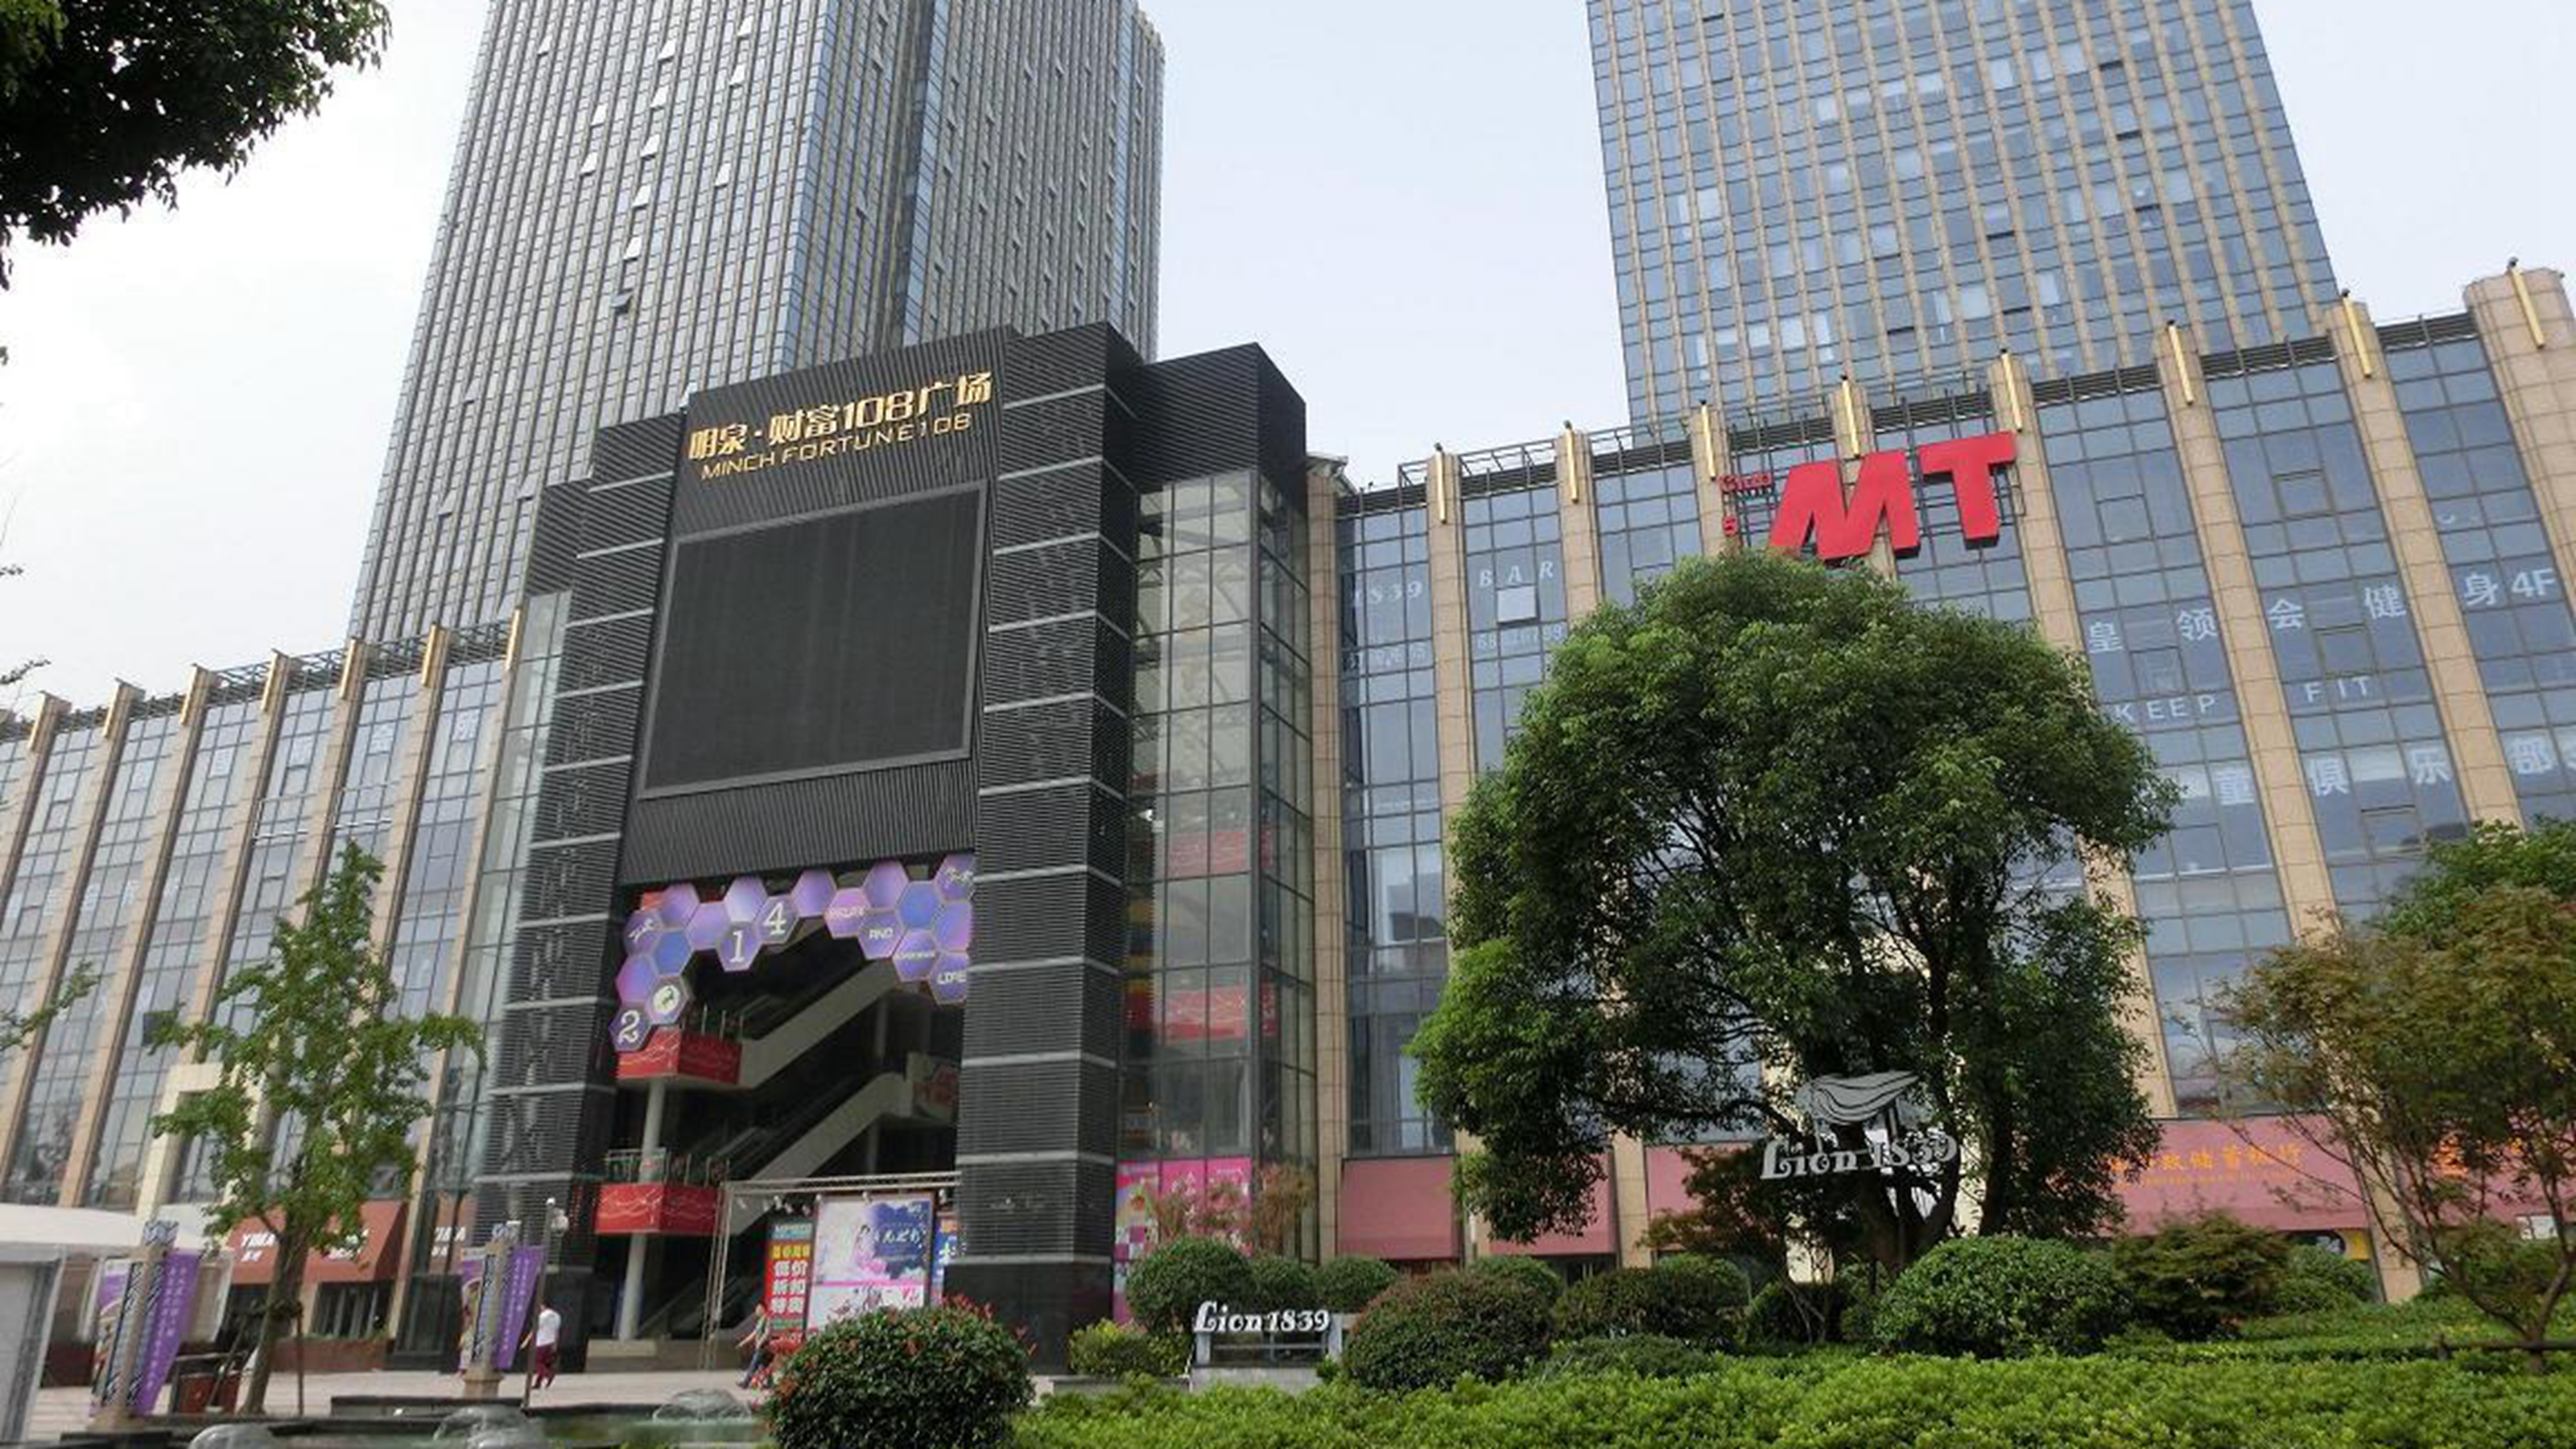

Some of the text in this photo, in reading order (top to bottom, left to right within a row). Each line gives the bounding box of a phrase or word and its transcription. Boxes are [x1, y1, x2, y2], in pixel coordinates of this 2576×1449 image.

[701, 449, 776, 480] MINCH
[2114, 675, 2371, 721] KEEP FIT
